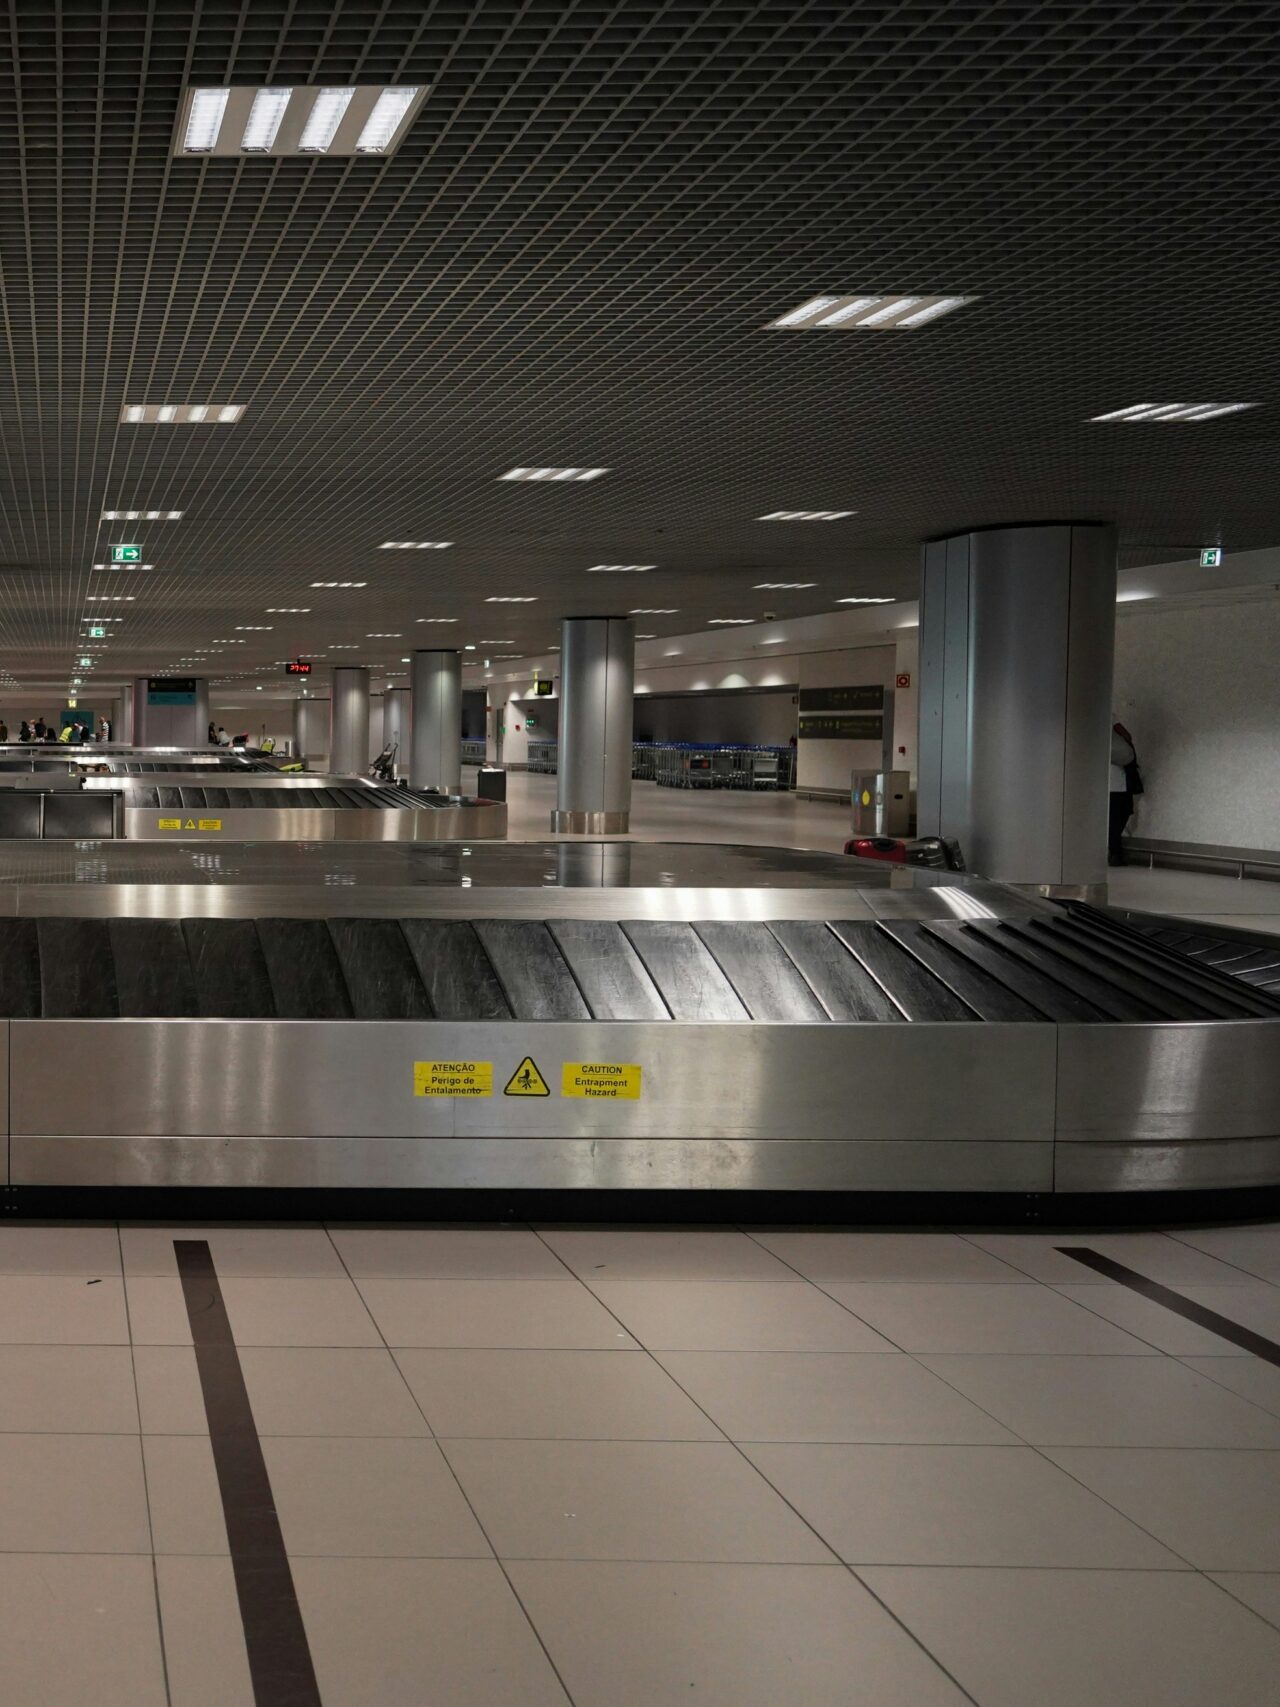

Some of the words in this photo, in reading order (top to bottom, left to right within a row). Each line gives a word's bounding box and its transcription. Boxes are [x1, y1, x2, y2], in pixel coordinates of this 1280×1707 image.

[431, 1062, 475, 1072] ATENÇÃO
[581, 1065, 623, 1074] CAUTION
[431, 1076, 461, 1086] Perigo
[463, 1076, 475, 1084] de
[575, 1077, 628, 1088] Entrapment
[424, 1086, 481, 1095] Entalamento
[584, 1087, 617, 1097] Hazard
